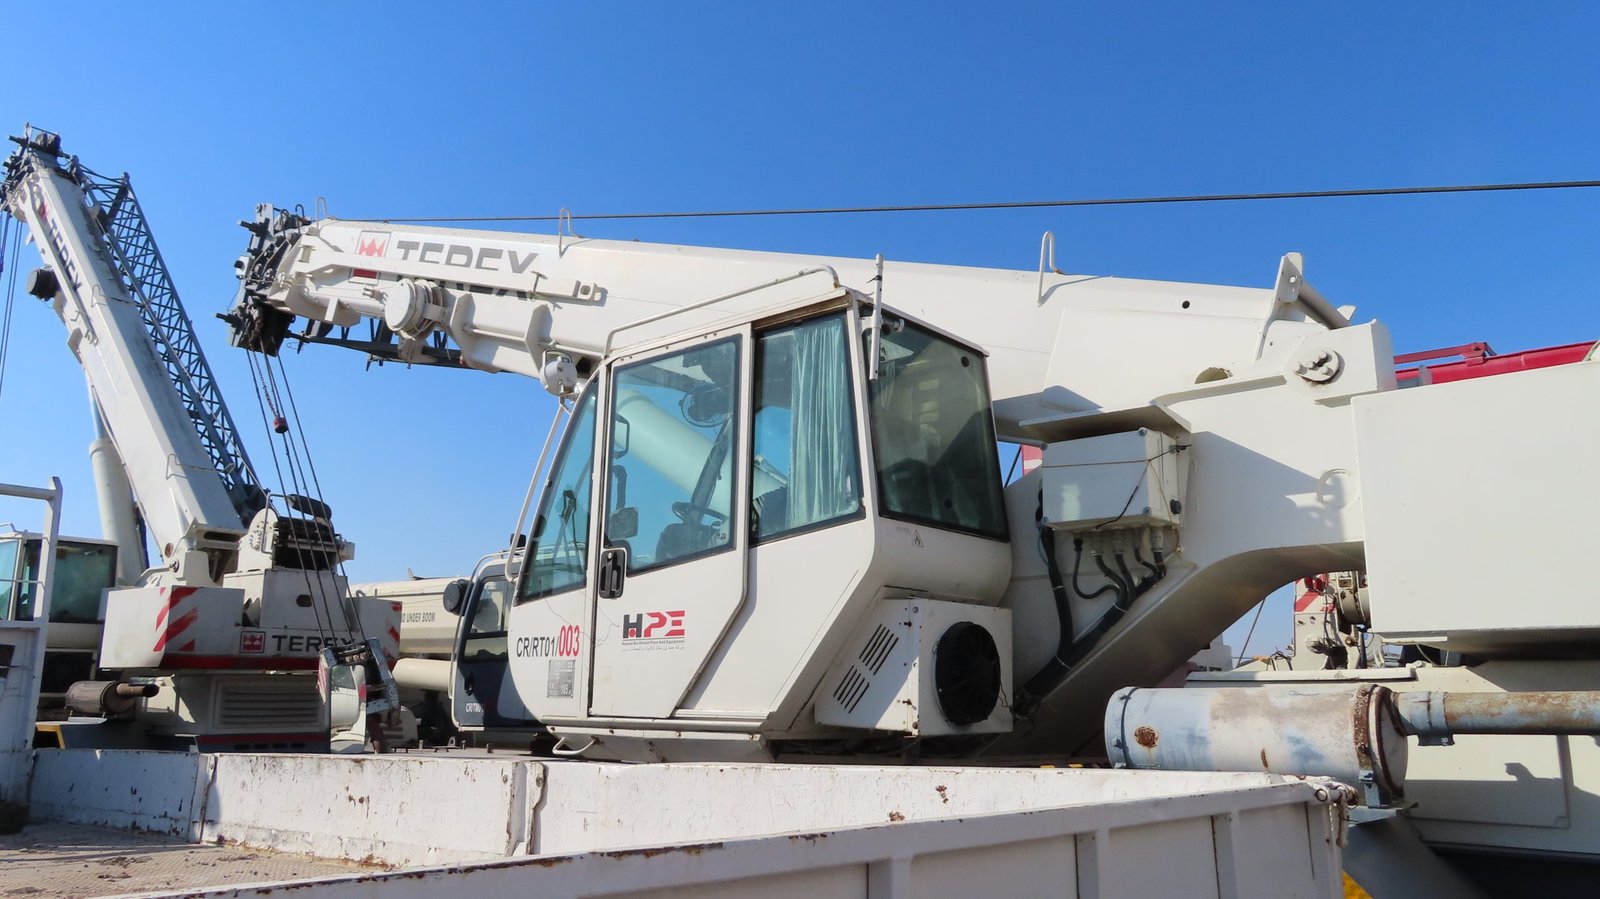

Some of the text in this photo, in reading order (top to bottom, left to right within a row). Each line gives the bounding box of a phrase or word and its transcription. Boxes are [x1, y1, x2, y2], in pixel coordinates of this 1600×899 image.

[406, 612, 421, 622] UNDER
[422, 612, 436, 622] BOOM
[622, 610, 686, 639] HPE
[516, 624, 580, 657] CR/RT01/003
